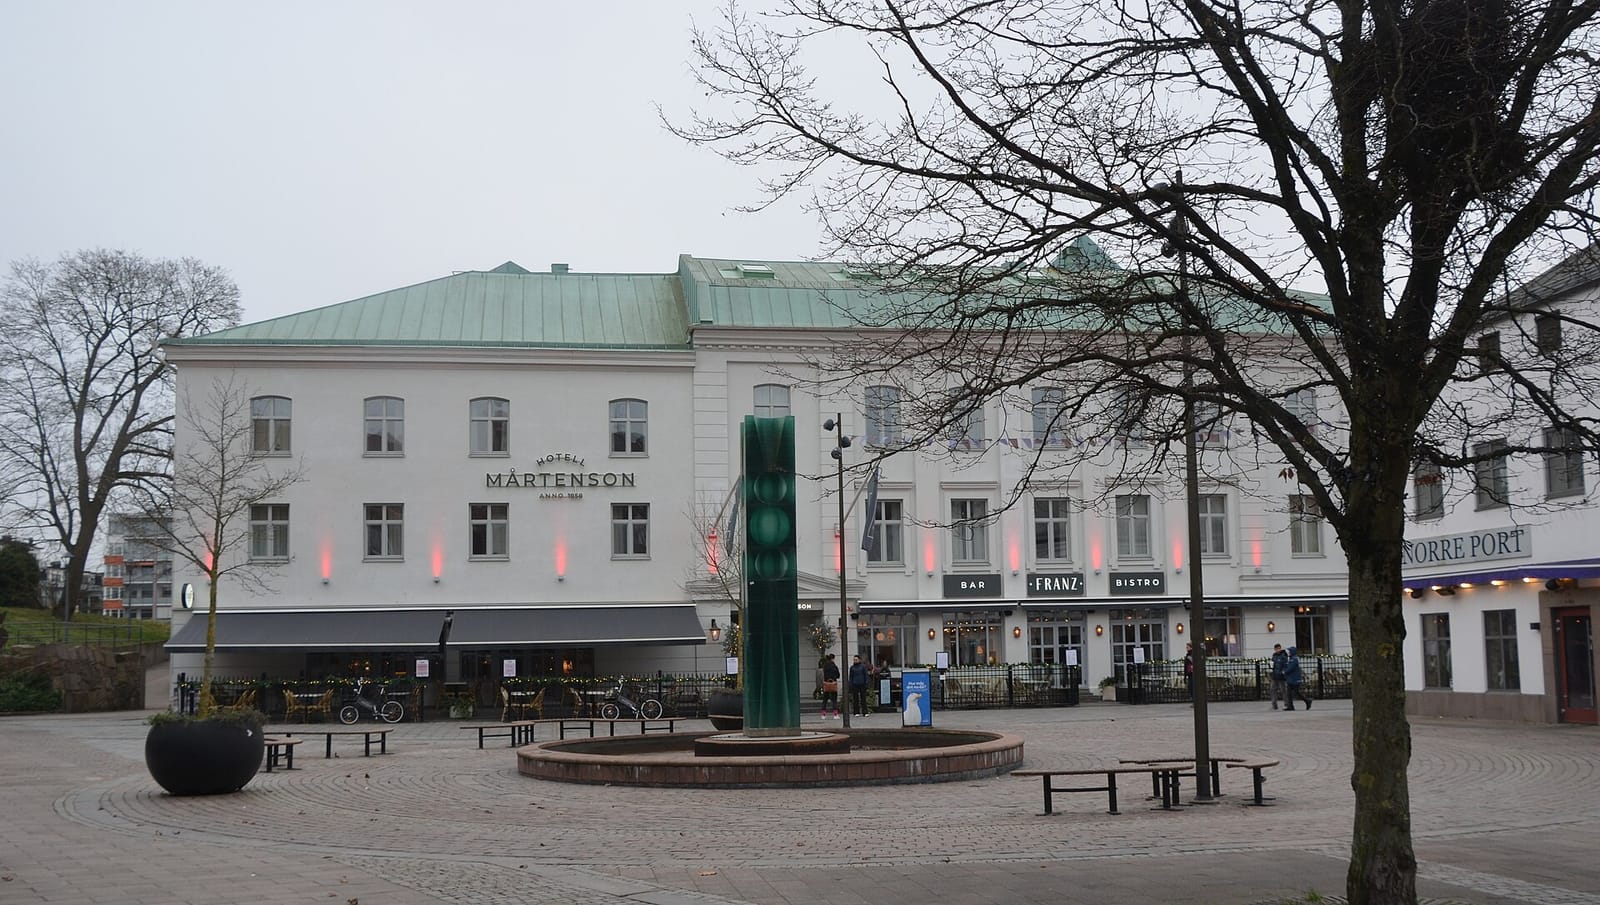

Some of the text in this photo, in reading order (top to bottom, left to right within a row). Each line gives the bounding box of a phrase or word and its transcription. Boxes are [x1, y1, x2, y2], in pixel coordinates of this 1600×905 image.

[536, 453, 585, 467] HOTELL
[486, 468, 634, 487] MÅRTENSON
[539, 492, 564, 500] ANNO
[1402, 529, 1524, 565] NORRE PORT
[961, 581, 986, 589] BAR
[1115, 578, 1160, 587] BISTRO
